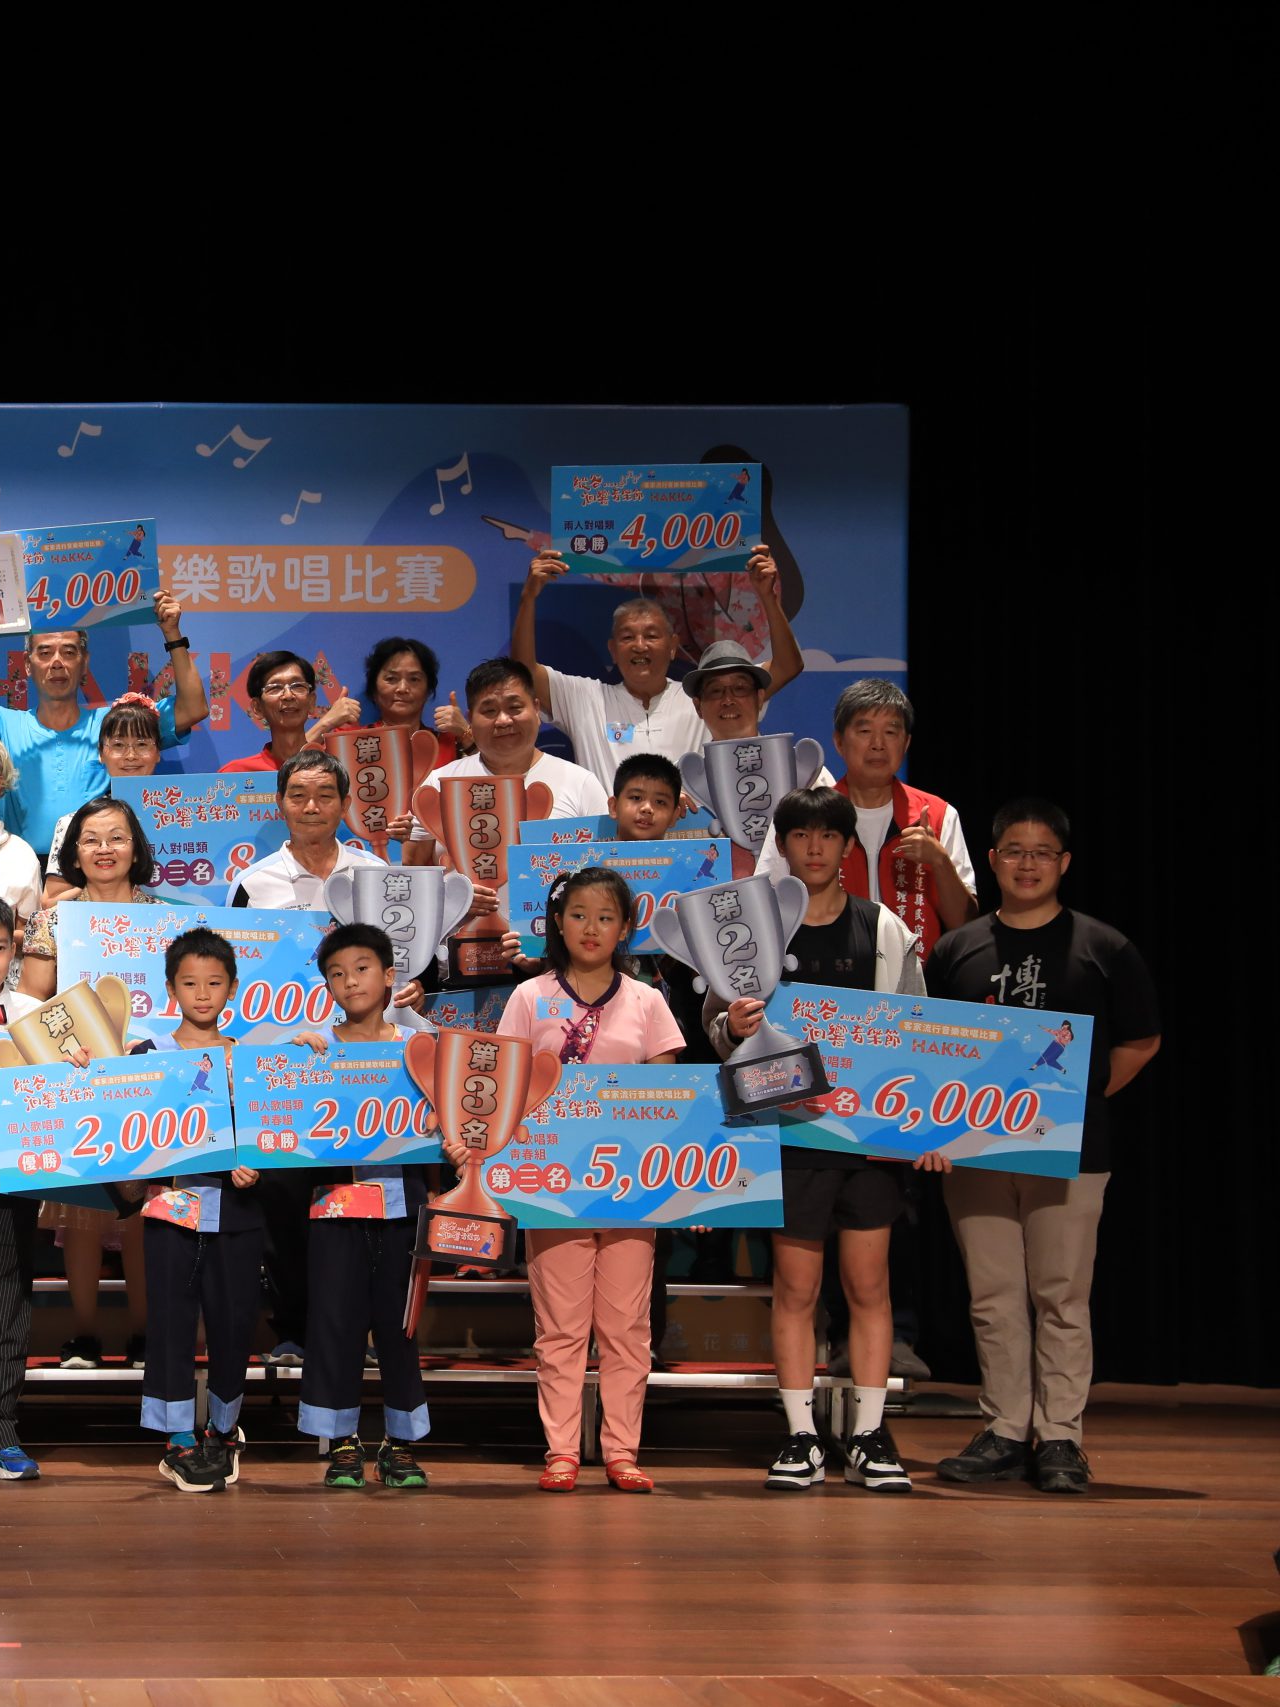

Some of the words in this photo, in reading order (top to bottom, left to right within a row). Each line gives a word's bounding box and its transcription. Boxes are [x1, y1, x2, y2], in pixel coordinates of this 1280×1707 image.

[650, 492, 694, 502] HAKKA
[564, 520, 615, 531] 兩人對唱類
[619, 512, 742, 558] 4,000
[573, 537, 606, 552] 優勝
[51, 552, 94, 564] HAKKA
[27, 568, 140, 619] 4,000
[354, 736, 389, 833] 第3名
[733, 744, 773, 842] 第2名
[142, 786, 182, 809] 縱谷
[249, 808, 286, 822] HAK
[467, 783, 501, 881] 第3名
[146, 841, 208, 856] 兩人對唱類
[620, 869, 661, 880] AKKA
[89, 914, 132, 936] 縱谷
[381, 872, 415, 974] 第2名
[217, 930, 275, 942] 行音樂歌唱比賽
[707, 889, 761, 997] 第2名
[101, 936, 173, 959] 洄響音樂
[233, 944, 263, 960] KKA
[990, 954, 1047, 1007] 博
[158, 979, 335, 1030] 1,000
[792, 998, 839, 1022] 縱谷
[38, 1001, 77, 1058] 第1
[903, 1021, 999, 1040] 客家流行音樂歌唱比賽
[911, 1039, 982, 1059] HAKKA
[256, 1054, 288, 1073] 縱谷
[13, 1074, 47, 1096] 縱谷
[341, 1073, 389, 1085] HAKKA
[102, 1086, 153, 1100] HAKKA
[459, 1040, 499, 1150] 第3名
[602, 1089, 692, 1100] 客家流行音樂歌唱比賽
[248, 1099, 303, 1112] 個人歌唱類
[523, 1100, 602, 1125] 響音樂節
[612, 1106, 679, 1121] HAKKA
[872, 1074, 1041, 1135] 6,000
[1034, 1125, 1045, 1135] 元
[7, 1118, 65, 1135] 個人歌唱類
[260, 1114, 293, 1126] 青春組
[308, 1096, 432, 1149] 2,000
[21, 1134, 55, 1147] 青春組
[72, 1104, 209, 1166] 2,000
[260, 1132, 296, 1151] 優勝
[510, 1134, 559, 1146] 人唱類
[21, 1152, 58, 1172] 優勝
[510, 1148, 547, 1161] 青春組
[489, 1166, 568, 1190] 第三名
[583, 1142, 740, 1202] 5,000
[737, 1177, 748, 1188] 元
